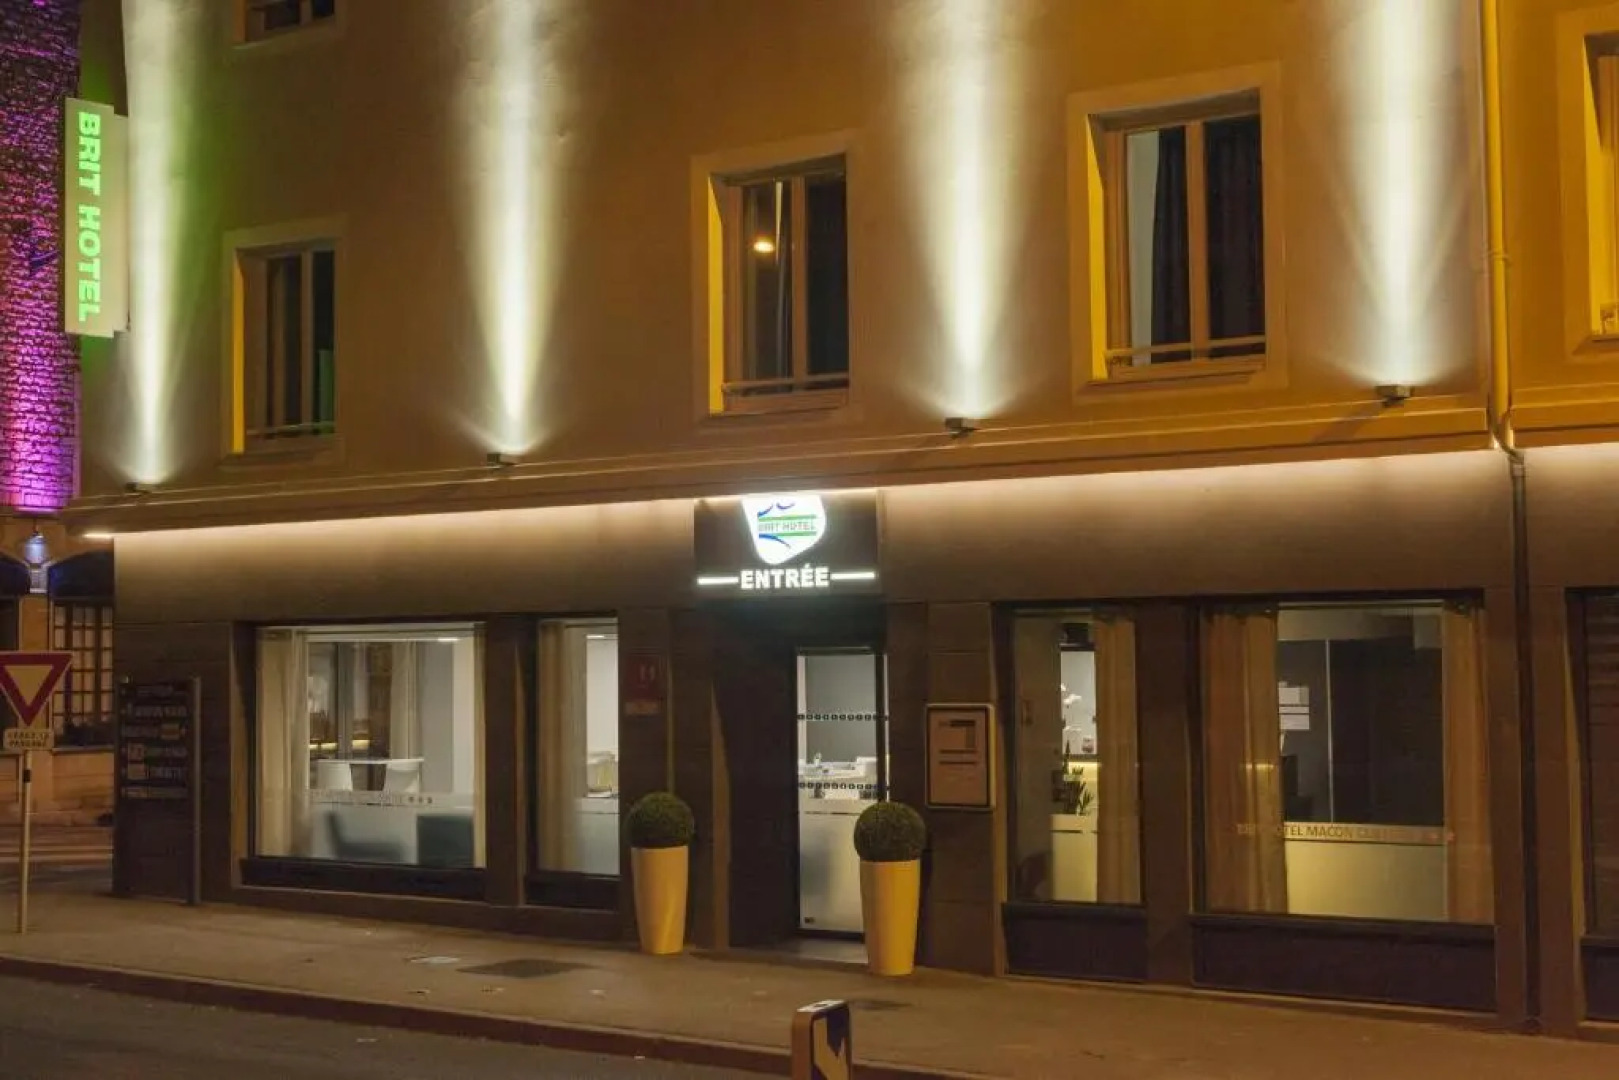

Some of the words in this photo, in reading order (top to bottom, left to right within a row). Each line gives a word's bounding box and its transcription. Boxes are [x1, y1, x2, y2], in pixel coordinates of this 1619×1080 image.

[77, 111, 101, 196] BRIT
[77, 203, 102, 323] HOTEL
[782, 521, 815, 531] HOTEL
[740, 563, 830, 590] ENTRÉE
